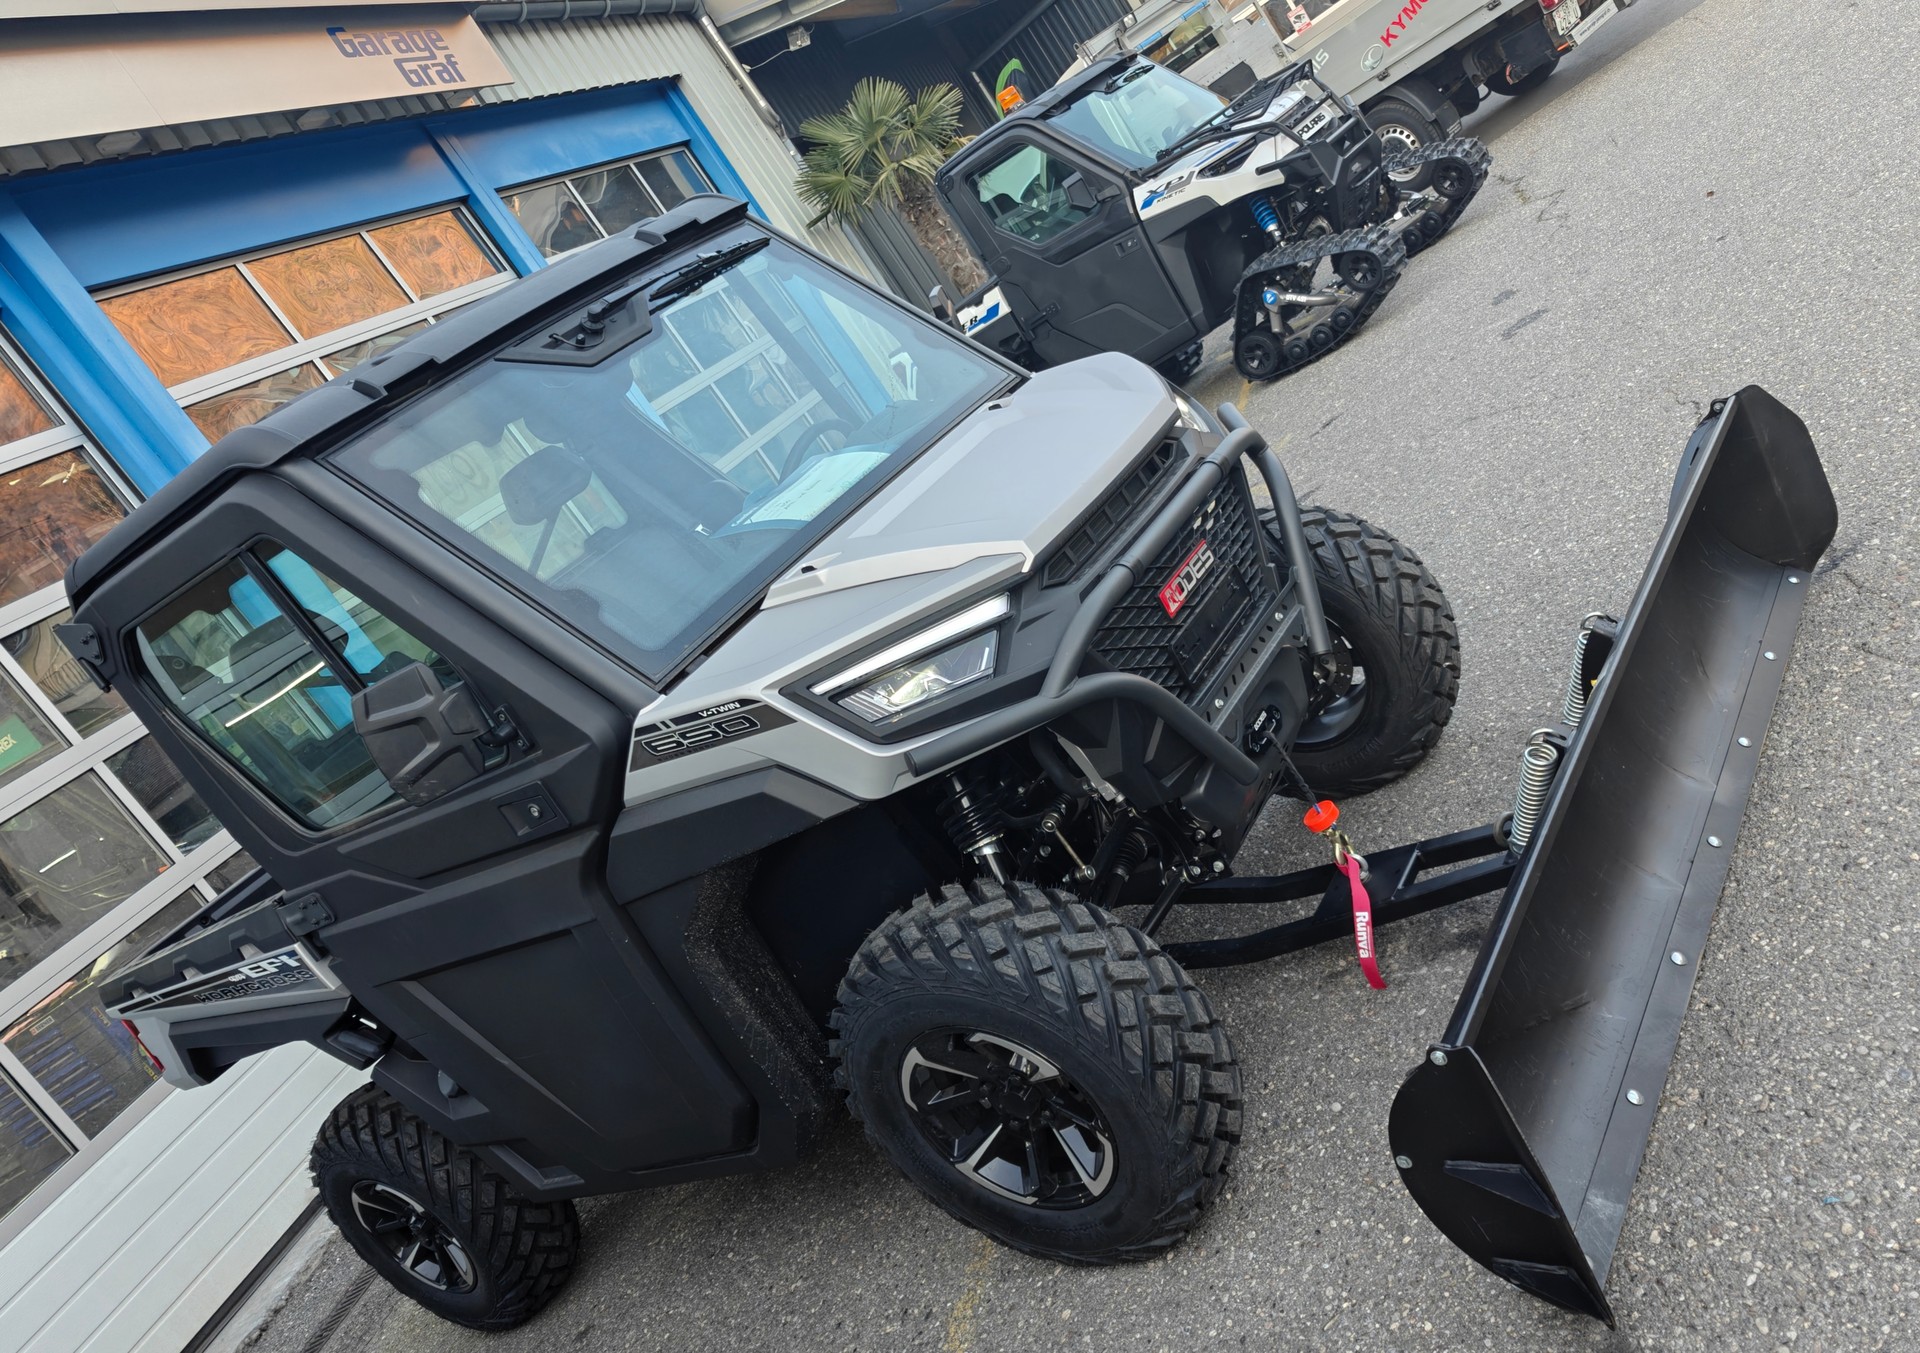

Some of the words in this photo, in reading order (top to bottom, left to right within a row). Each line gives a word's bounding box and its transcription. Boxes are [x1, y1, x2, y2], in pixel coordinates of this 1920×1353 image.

[1380, 0, 1429, 48] KYM
[325, 26, 450, 61] Garage
[393, 54, 467, 88] Graf
[1296, 111, 1326, 138] POLARIS
[1157, 187, 1186, 203] KINETIC
[697, 701, 741, 718] V-TWIN
[641, 713, 761, 756] 650
[1355, 911, 1370, 959] Runva
[238, 954, 301, 979] EFI
